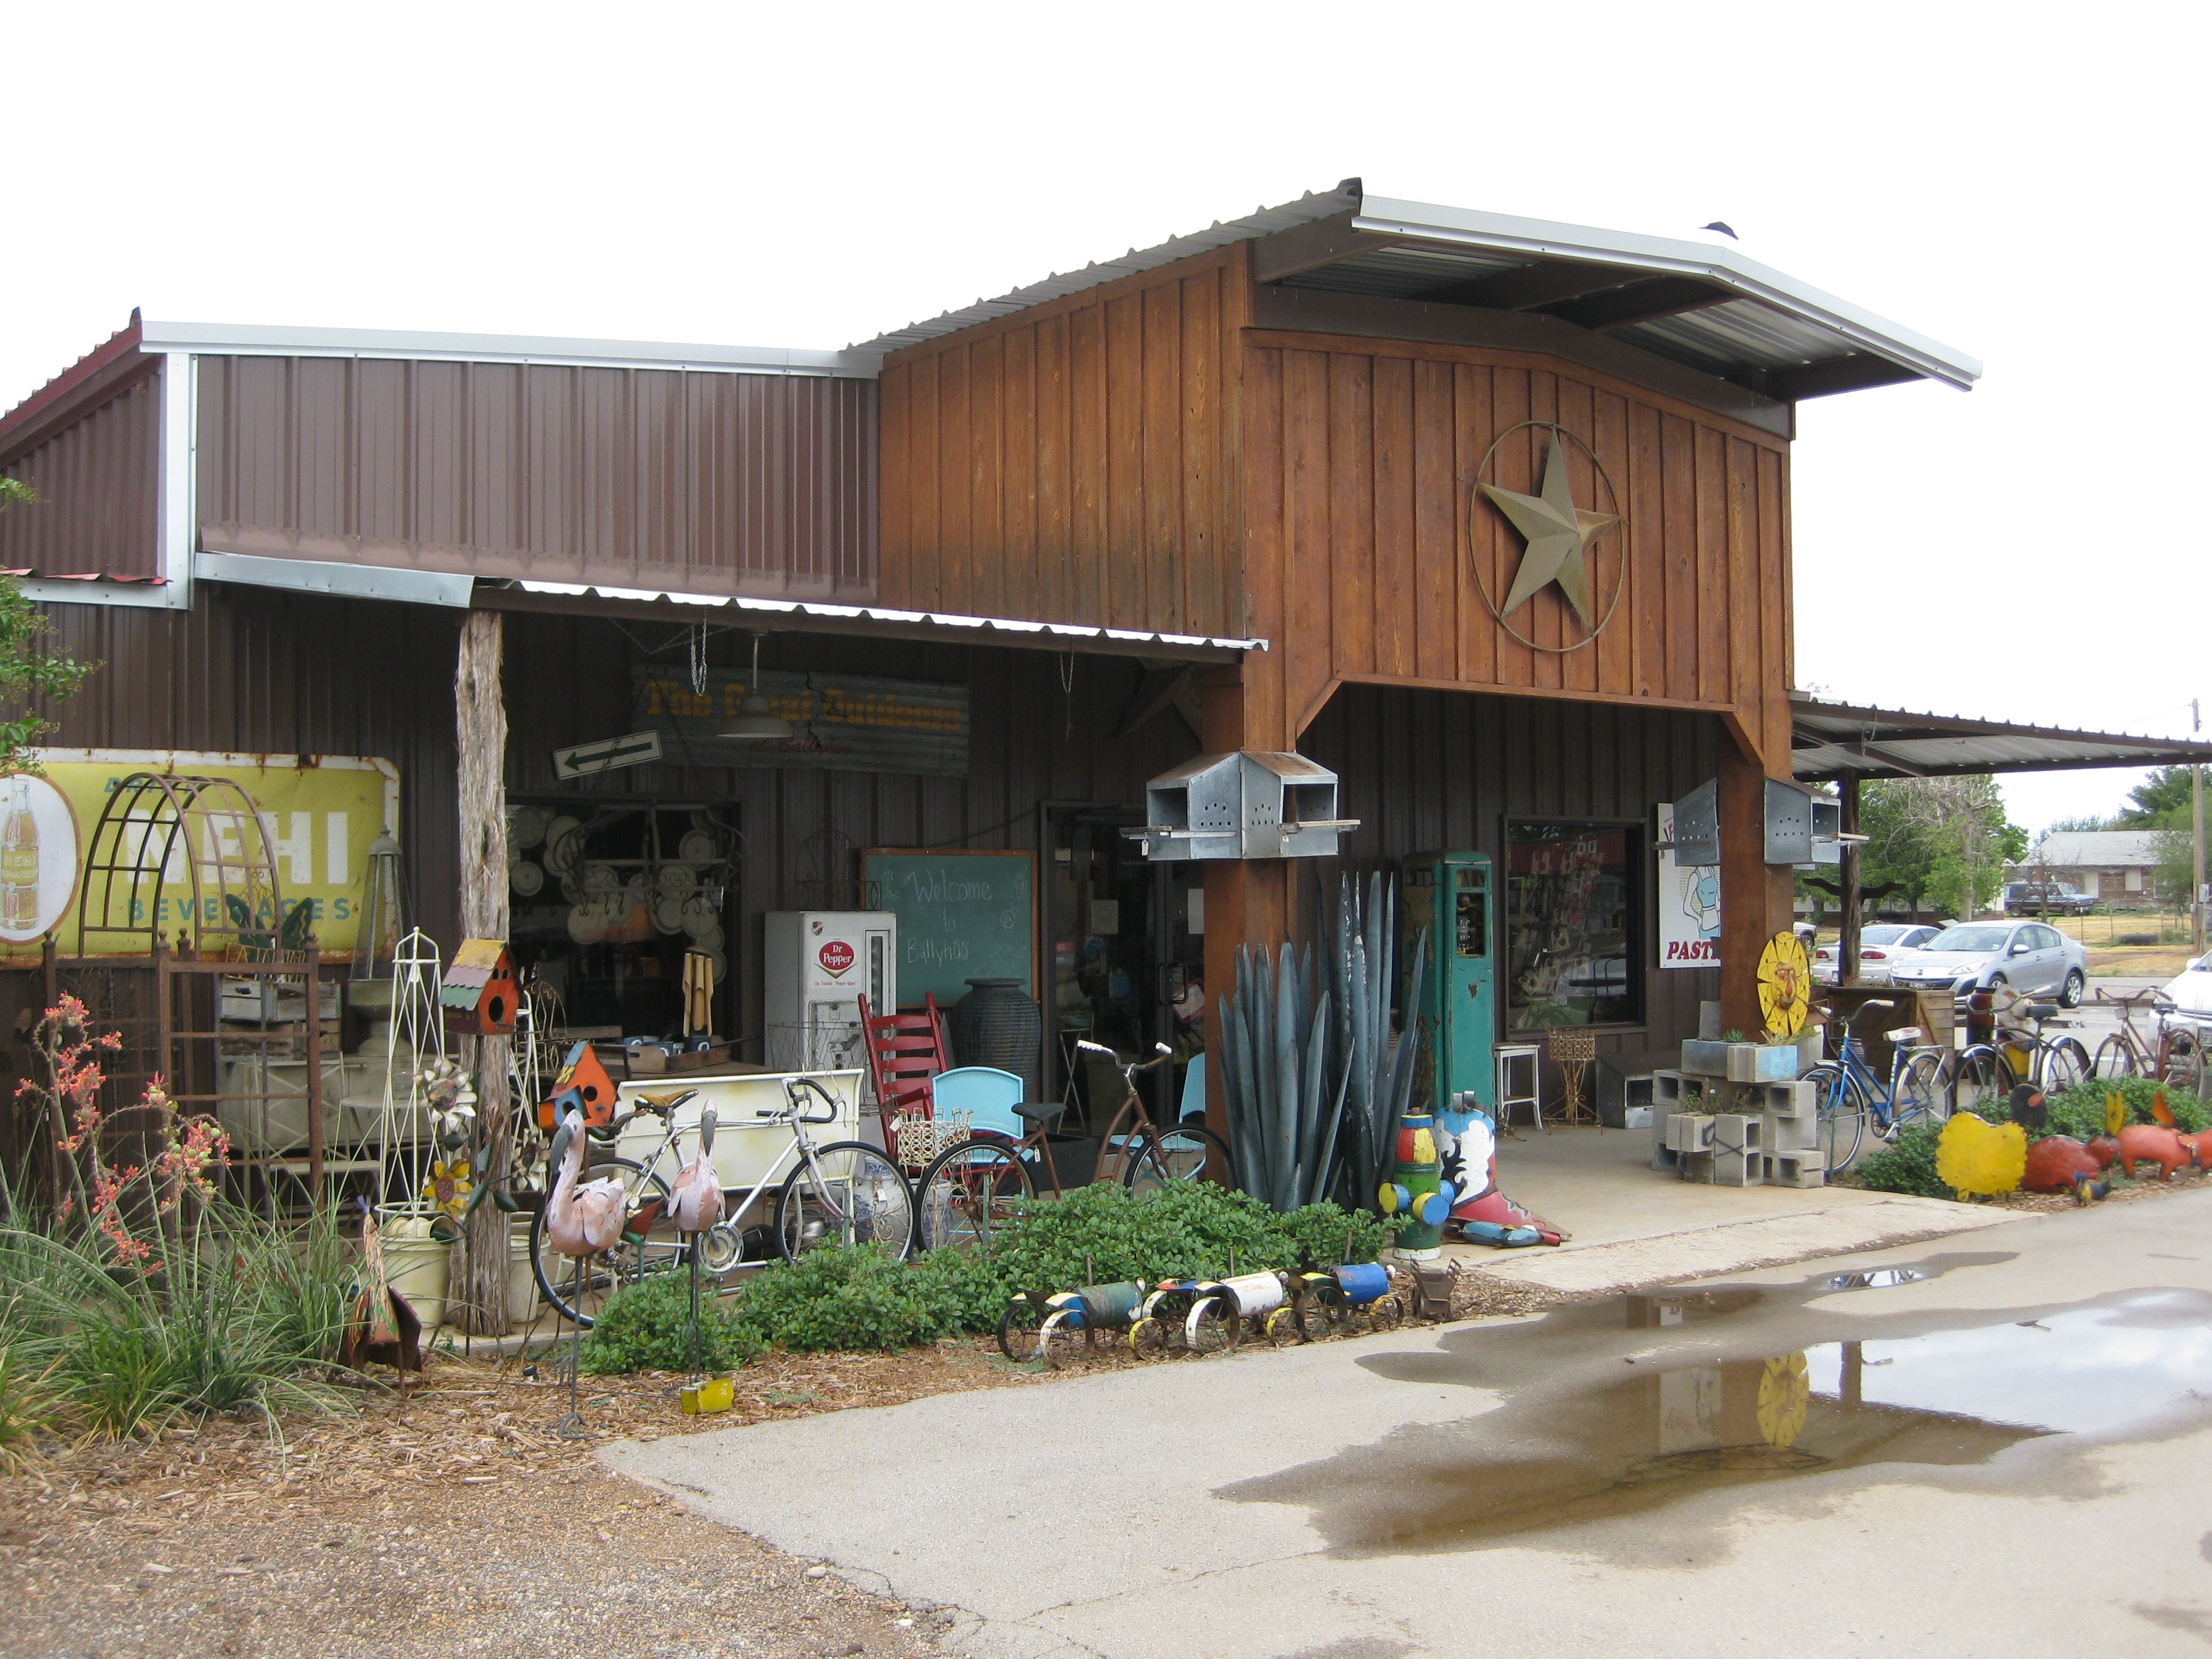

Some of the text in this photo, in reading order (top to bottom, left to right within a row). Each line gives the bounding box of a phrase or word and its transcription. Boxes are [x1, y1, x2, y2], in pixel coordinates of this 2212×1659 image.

[642, 680, 962, 731] The Geat Outdoors
[126, 808, 348, 884] NEHI
[907, 868, 992, 903] Welcome
[127, 897, 350, 921] BEVEAGES
[943, 908, 956, 933] to
[823, 952, 852, 966] Pepper
[832, 944, 843, 954] Dr
